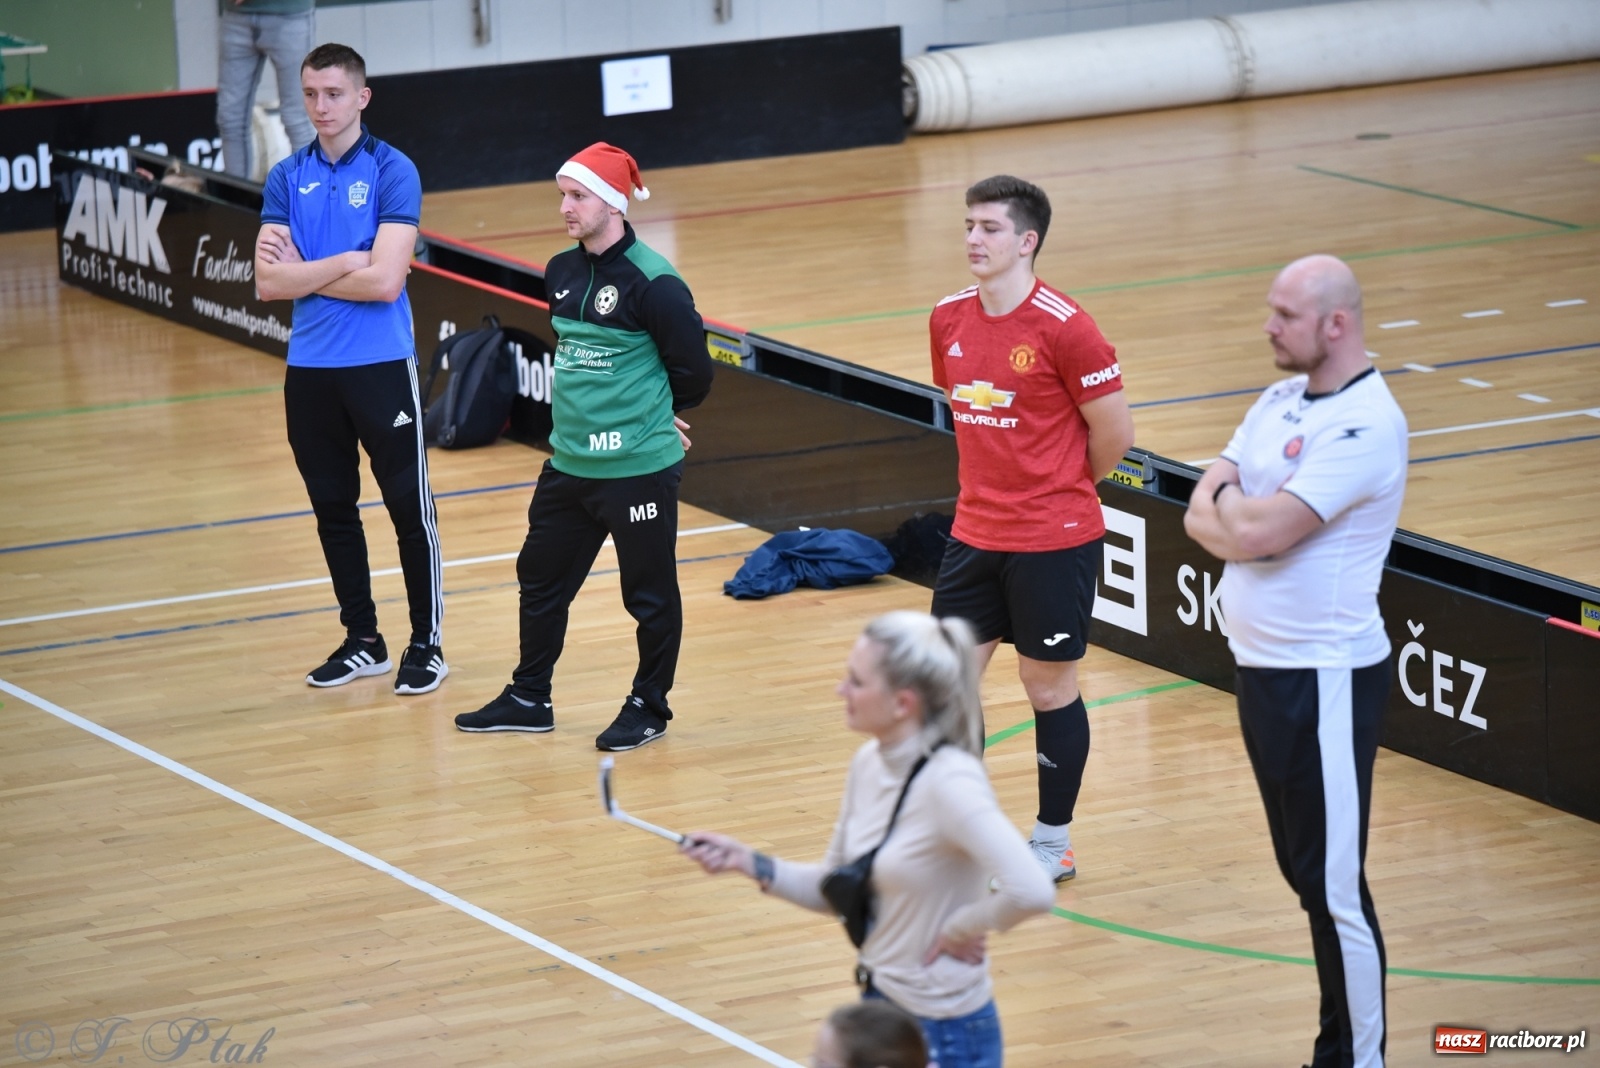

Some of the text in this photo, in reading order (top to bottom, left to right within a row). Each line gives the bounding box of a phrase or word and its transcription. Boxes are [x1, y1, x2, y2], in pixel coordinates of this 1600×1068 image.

[62, 173, 171, 275] AMK
[63, 242, 173, 308] Profi-Technic
[953, 411, 1018, 428] CHEVROLET
[589, 431, 622, 452] MB
[629, 502, 658, 523] MB
[1398, 619, 1487, 730] ČEZ
